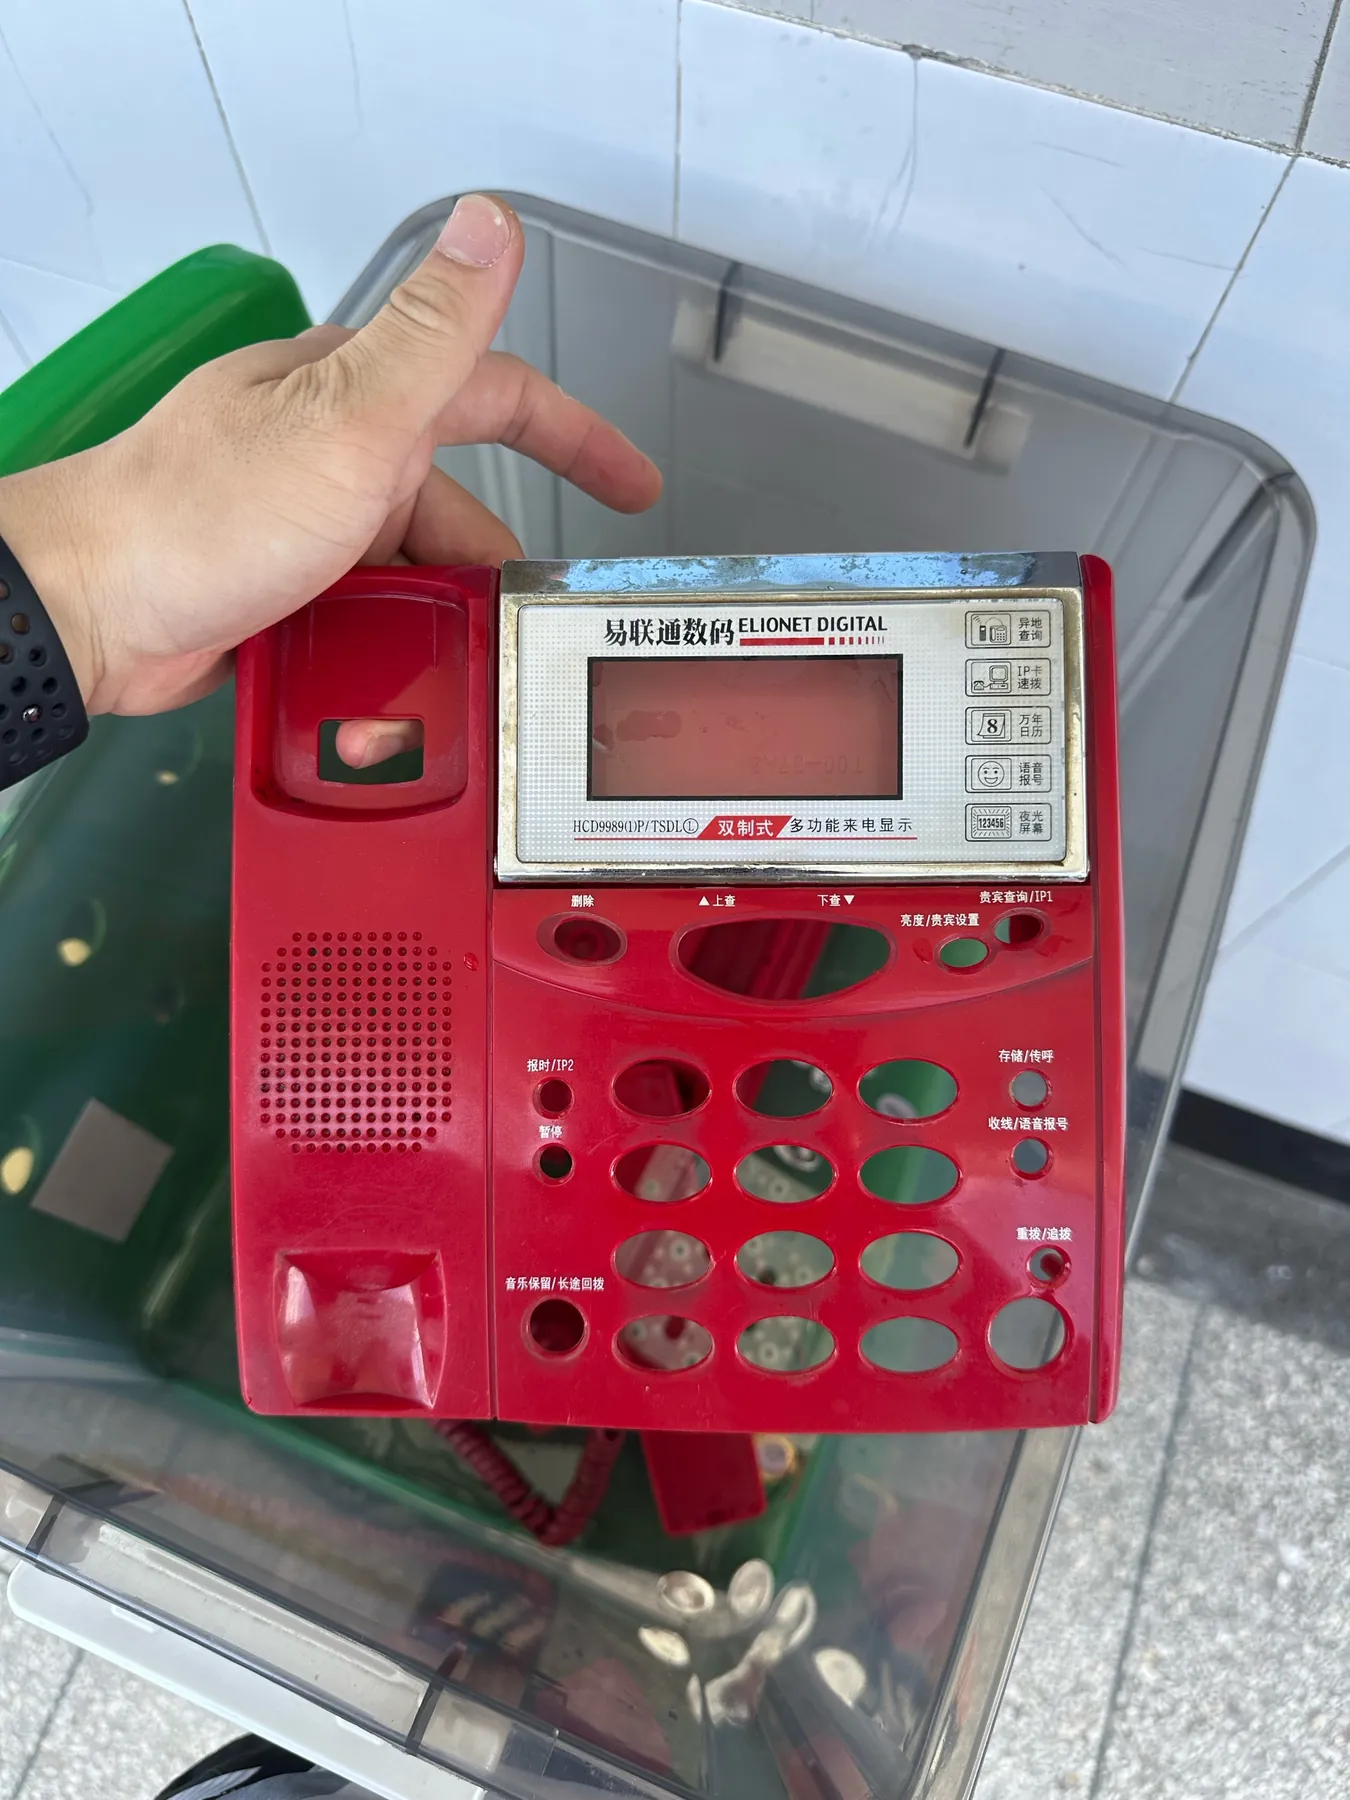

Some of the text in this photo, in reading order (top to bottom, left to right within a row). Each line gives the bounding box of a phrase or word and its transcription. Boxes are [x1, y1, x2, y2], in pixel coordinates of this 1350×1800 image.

[1018, 617, 1043, 629] 异地
[603, 616, 888, 647] 易联通数码 ELIONET DIGITAL
[1018, 629, 1043, 642] 查询
[1017, 665, 1042, 677] IP卡
[1017, 677, 1042, 690] 速拨
[1019, 713, 1043, 725] 万年
[986, 718, 998, 734] 8
[1019, 725, 1043, 738] 日历
[1019, 762, 1043, 774] 语音
[1019, 774, 1043, 786] 报号
[1019, 810, 1043, 822] 夜光
[717, 819, 774, 837] 双制式
[790, 817, 914, 833] 多功能来电显示
[978, 817, 1004, 829] 123456
[1019, 822, 1043, 835] 屏幕
[571, 894, 595, 907] 删除
[712, 894, 736, 907] 上查
[817, 894, 841, 907] 下查
[979, 890, 1053, 904] 贵宾查询/IP1
[900, 913, 980, 927] 亮度/贵宾设置
[998, 1049, 1054, 1063] 存储/传呼
[527, 1059, 574, 1072] 报时/IP2
[988, 1116, 1069, 1131] 收线/语音报号
[539, 1125, 563, 1139] 暂停
[1016, 1227, 1072, 1242] 重拨/追拨
[505, 1276, 605, 1291] 音乐保留/长途回拨
